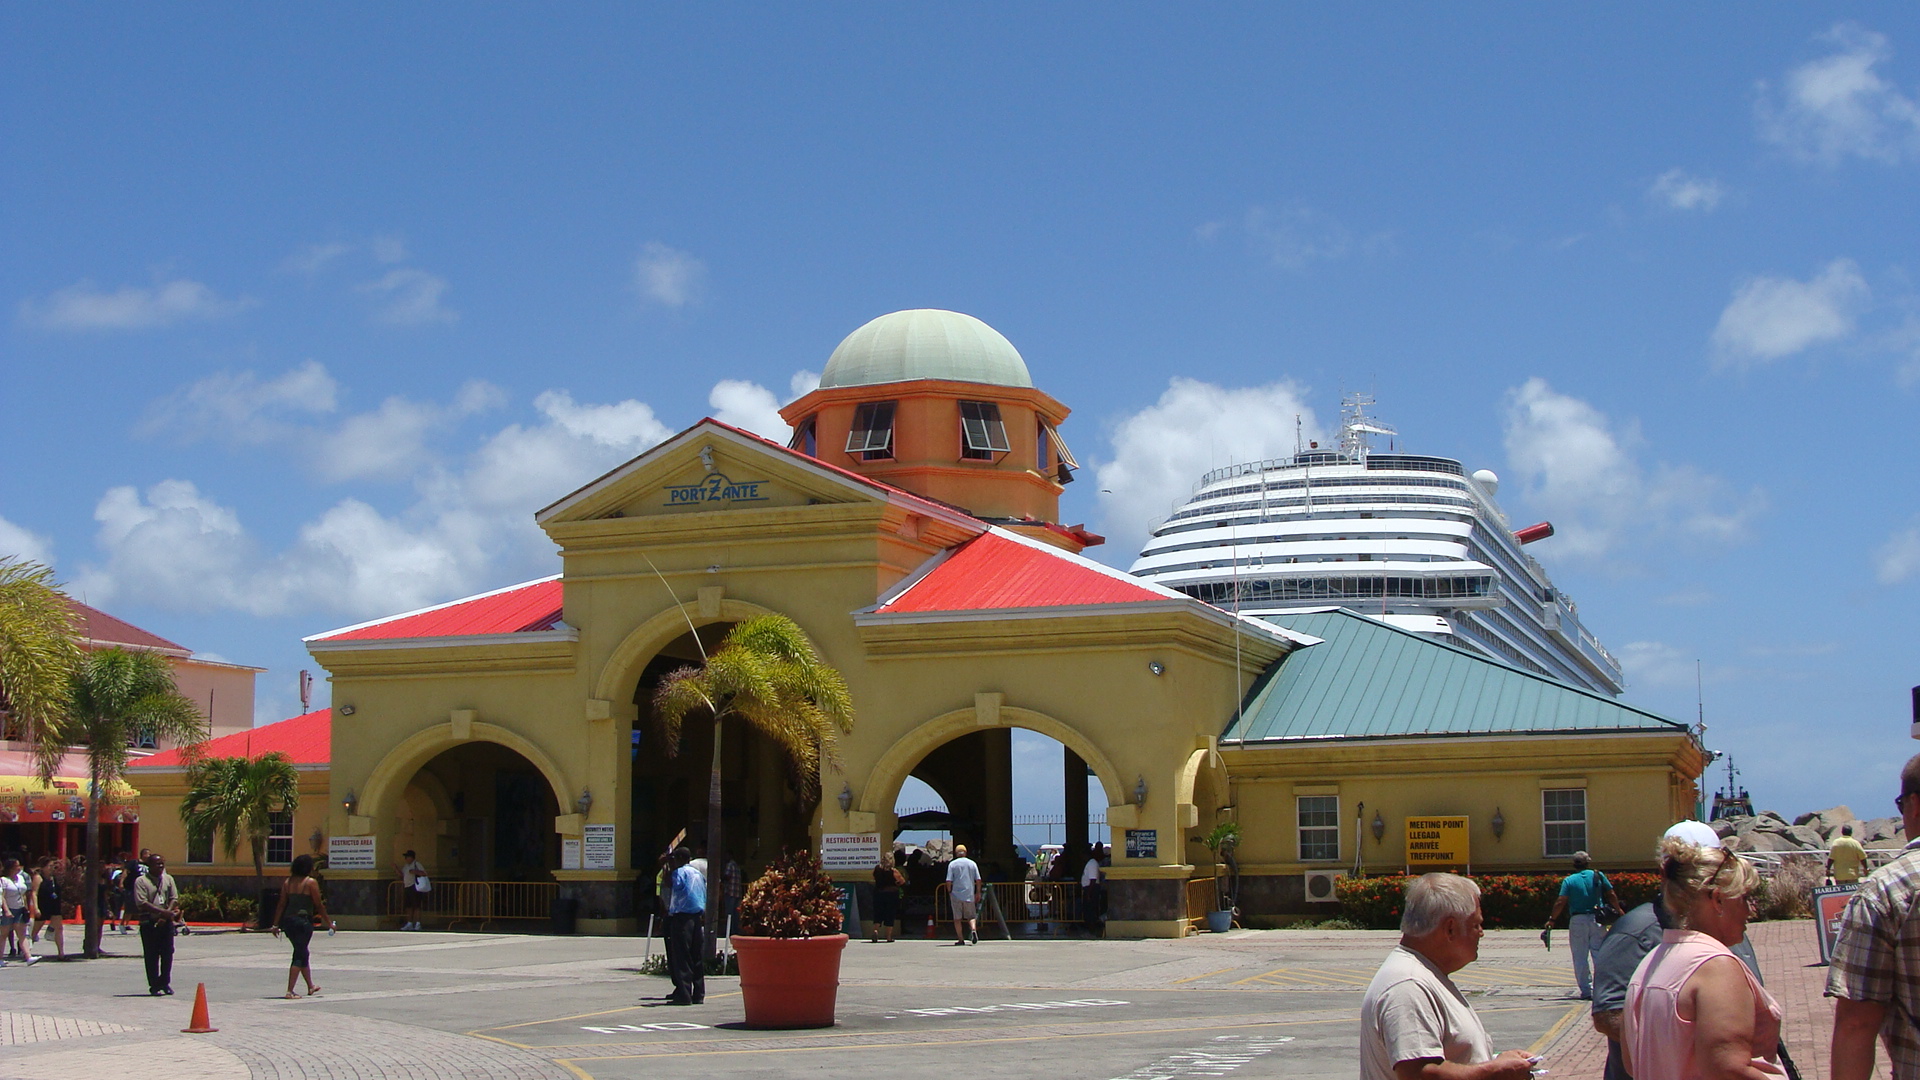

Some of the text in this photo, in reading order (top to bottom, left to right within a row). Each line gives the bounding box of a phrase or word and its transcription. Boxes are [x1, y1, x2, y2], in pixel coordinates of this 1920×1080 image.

[57, 788, 78, 796] CASINO
[1409, 820, 1464, 829] MEETING POINT
[1409, 831, 1440, 840] LLEGADA
[826, 836, 861, 844] RESTRICTED
[1410, 852, 1454, 860] TREFFPUNKT
[1814, 886, 1842, 894] HARLEY
[580, 1021, 711, 1035] NO
